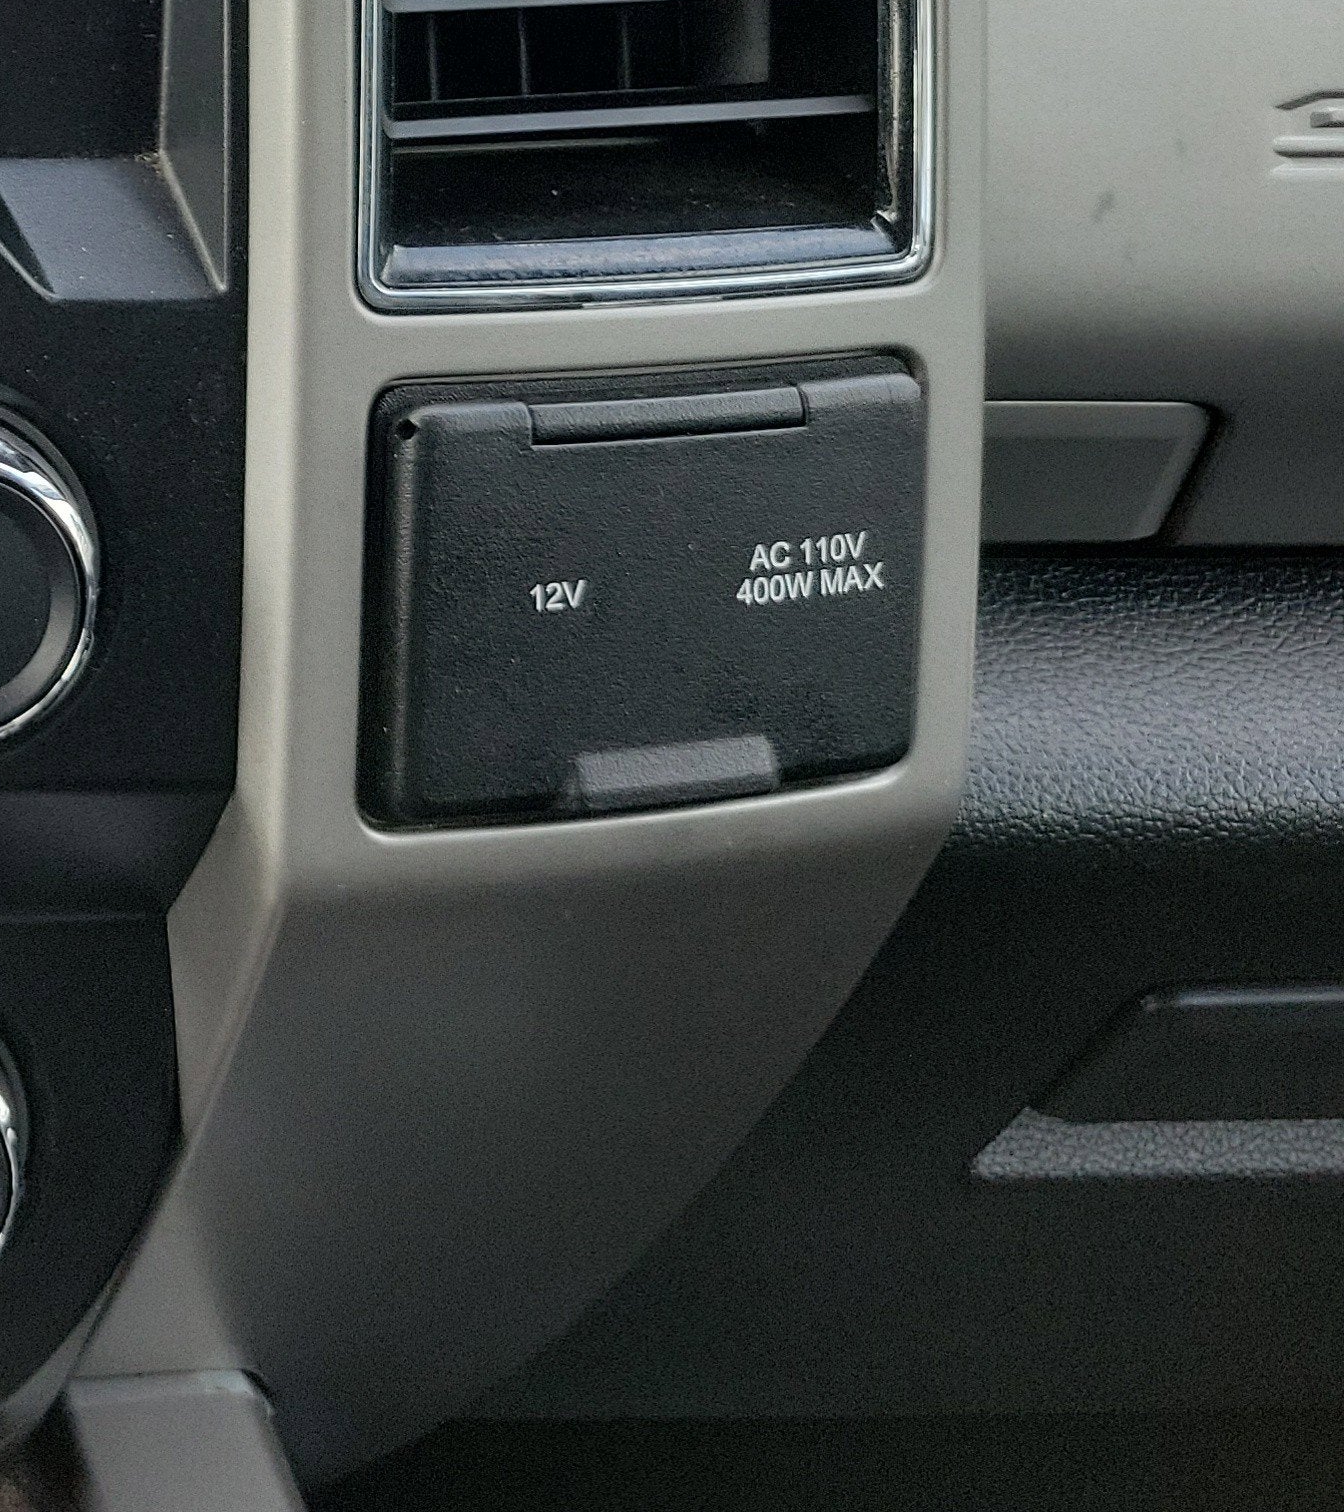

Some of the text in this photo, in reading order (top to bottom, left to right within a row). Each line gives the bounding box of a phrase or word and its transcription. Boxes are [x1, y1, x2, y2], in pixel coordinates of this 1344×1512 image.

[749, 531, 868, 571] AC 110V
[529, 579, 586, 612] 12V
[736, 561, 885, 606] 400W MAX
